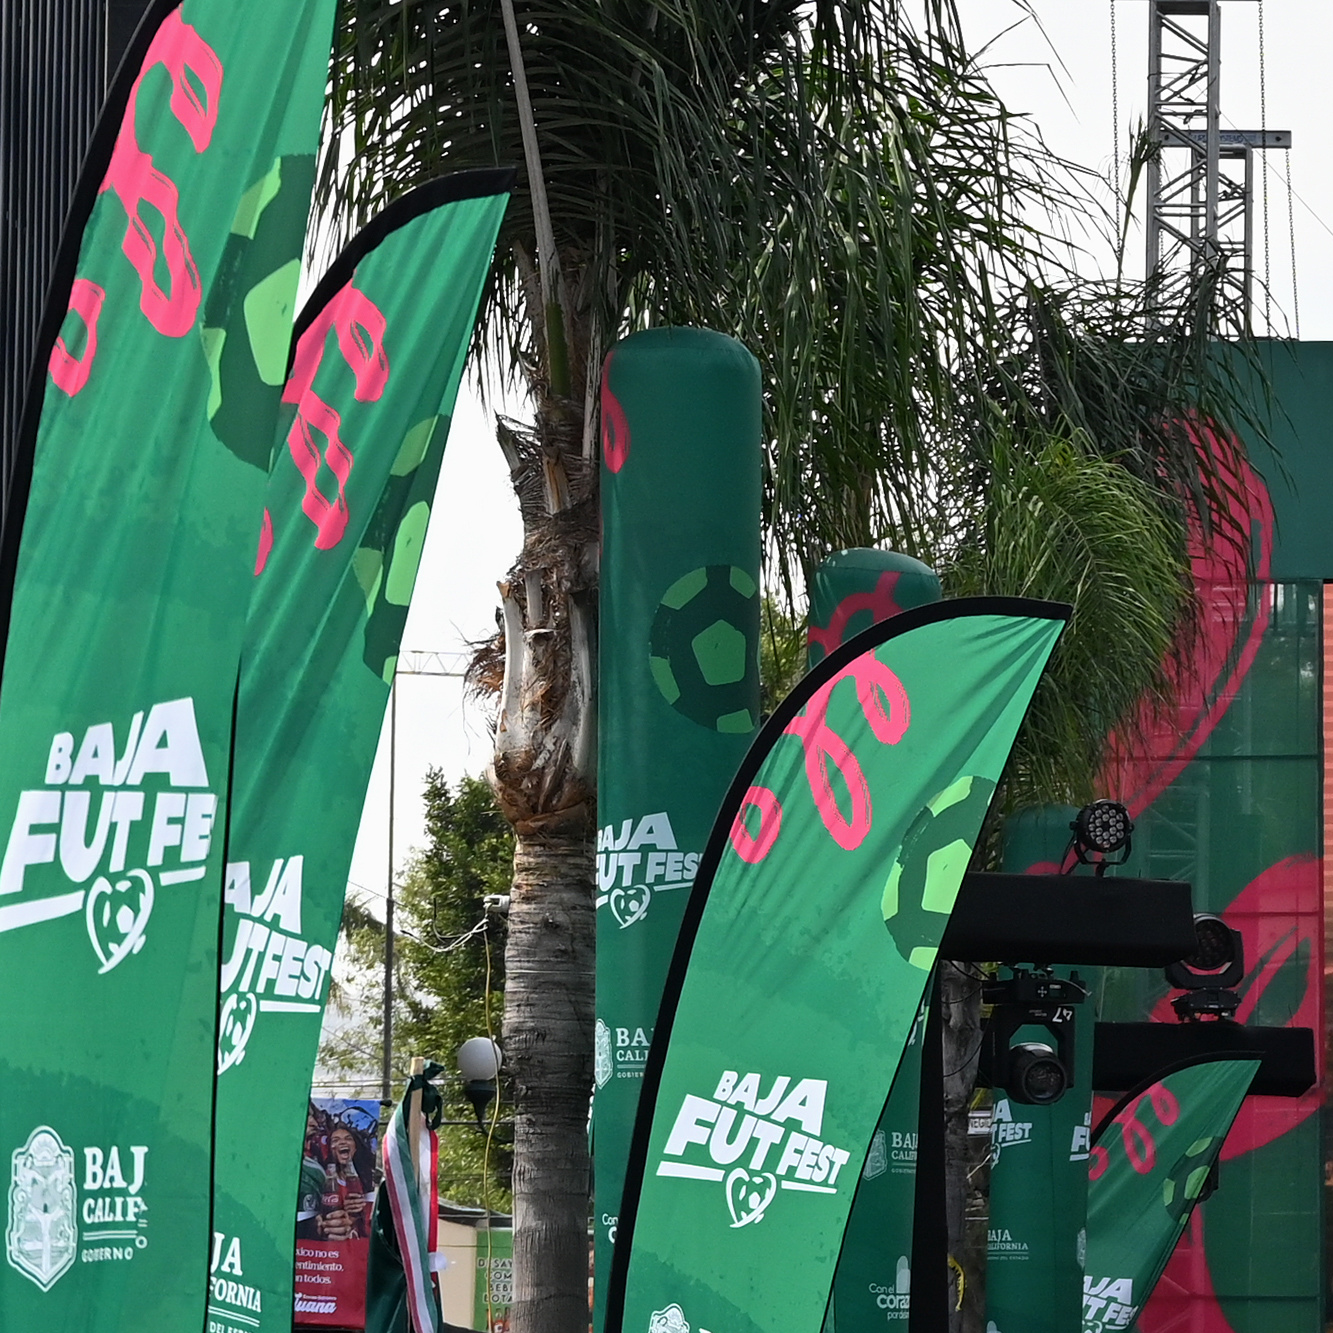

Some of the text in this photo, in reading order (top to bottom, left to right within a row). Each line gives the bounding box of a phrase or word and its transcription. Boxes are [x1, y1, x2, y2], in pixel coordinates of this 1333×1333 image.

[44, 696, 210, 787] BAJA
[0, 789, 145, 895] FUT
[645, 851, 703, 884] FES
[256, 930, 332, 1001] FEST
[616, 1027, 655, 1048] BA
[663, 1093, 851, 1185] FUT FEST
[713, 1070, 828, 1137] BAJA
